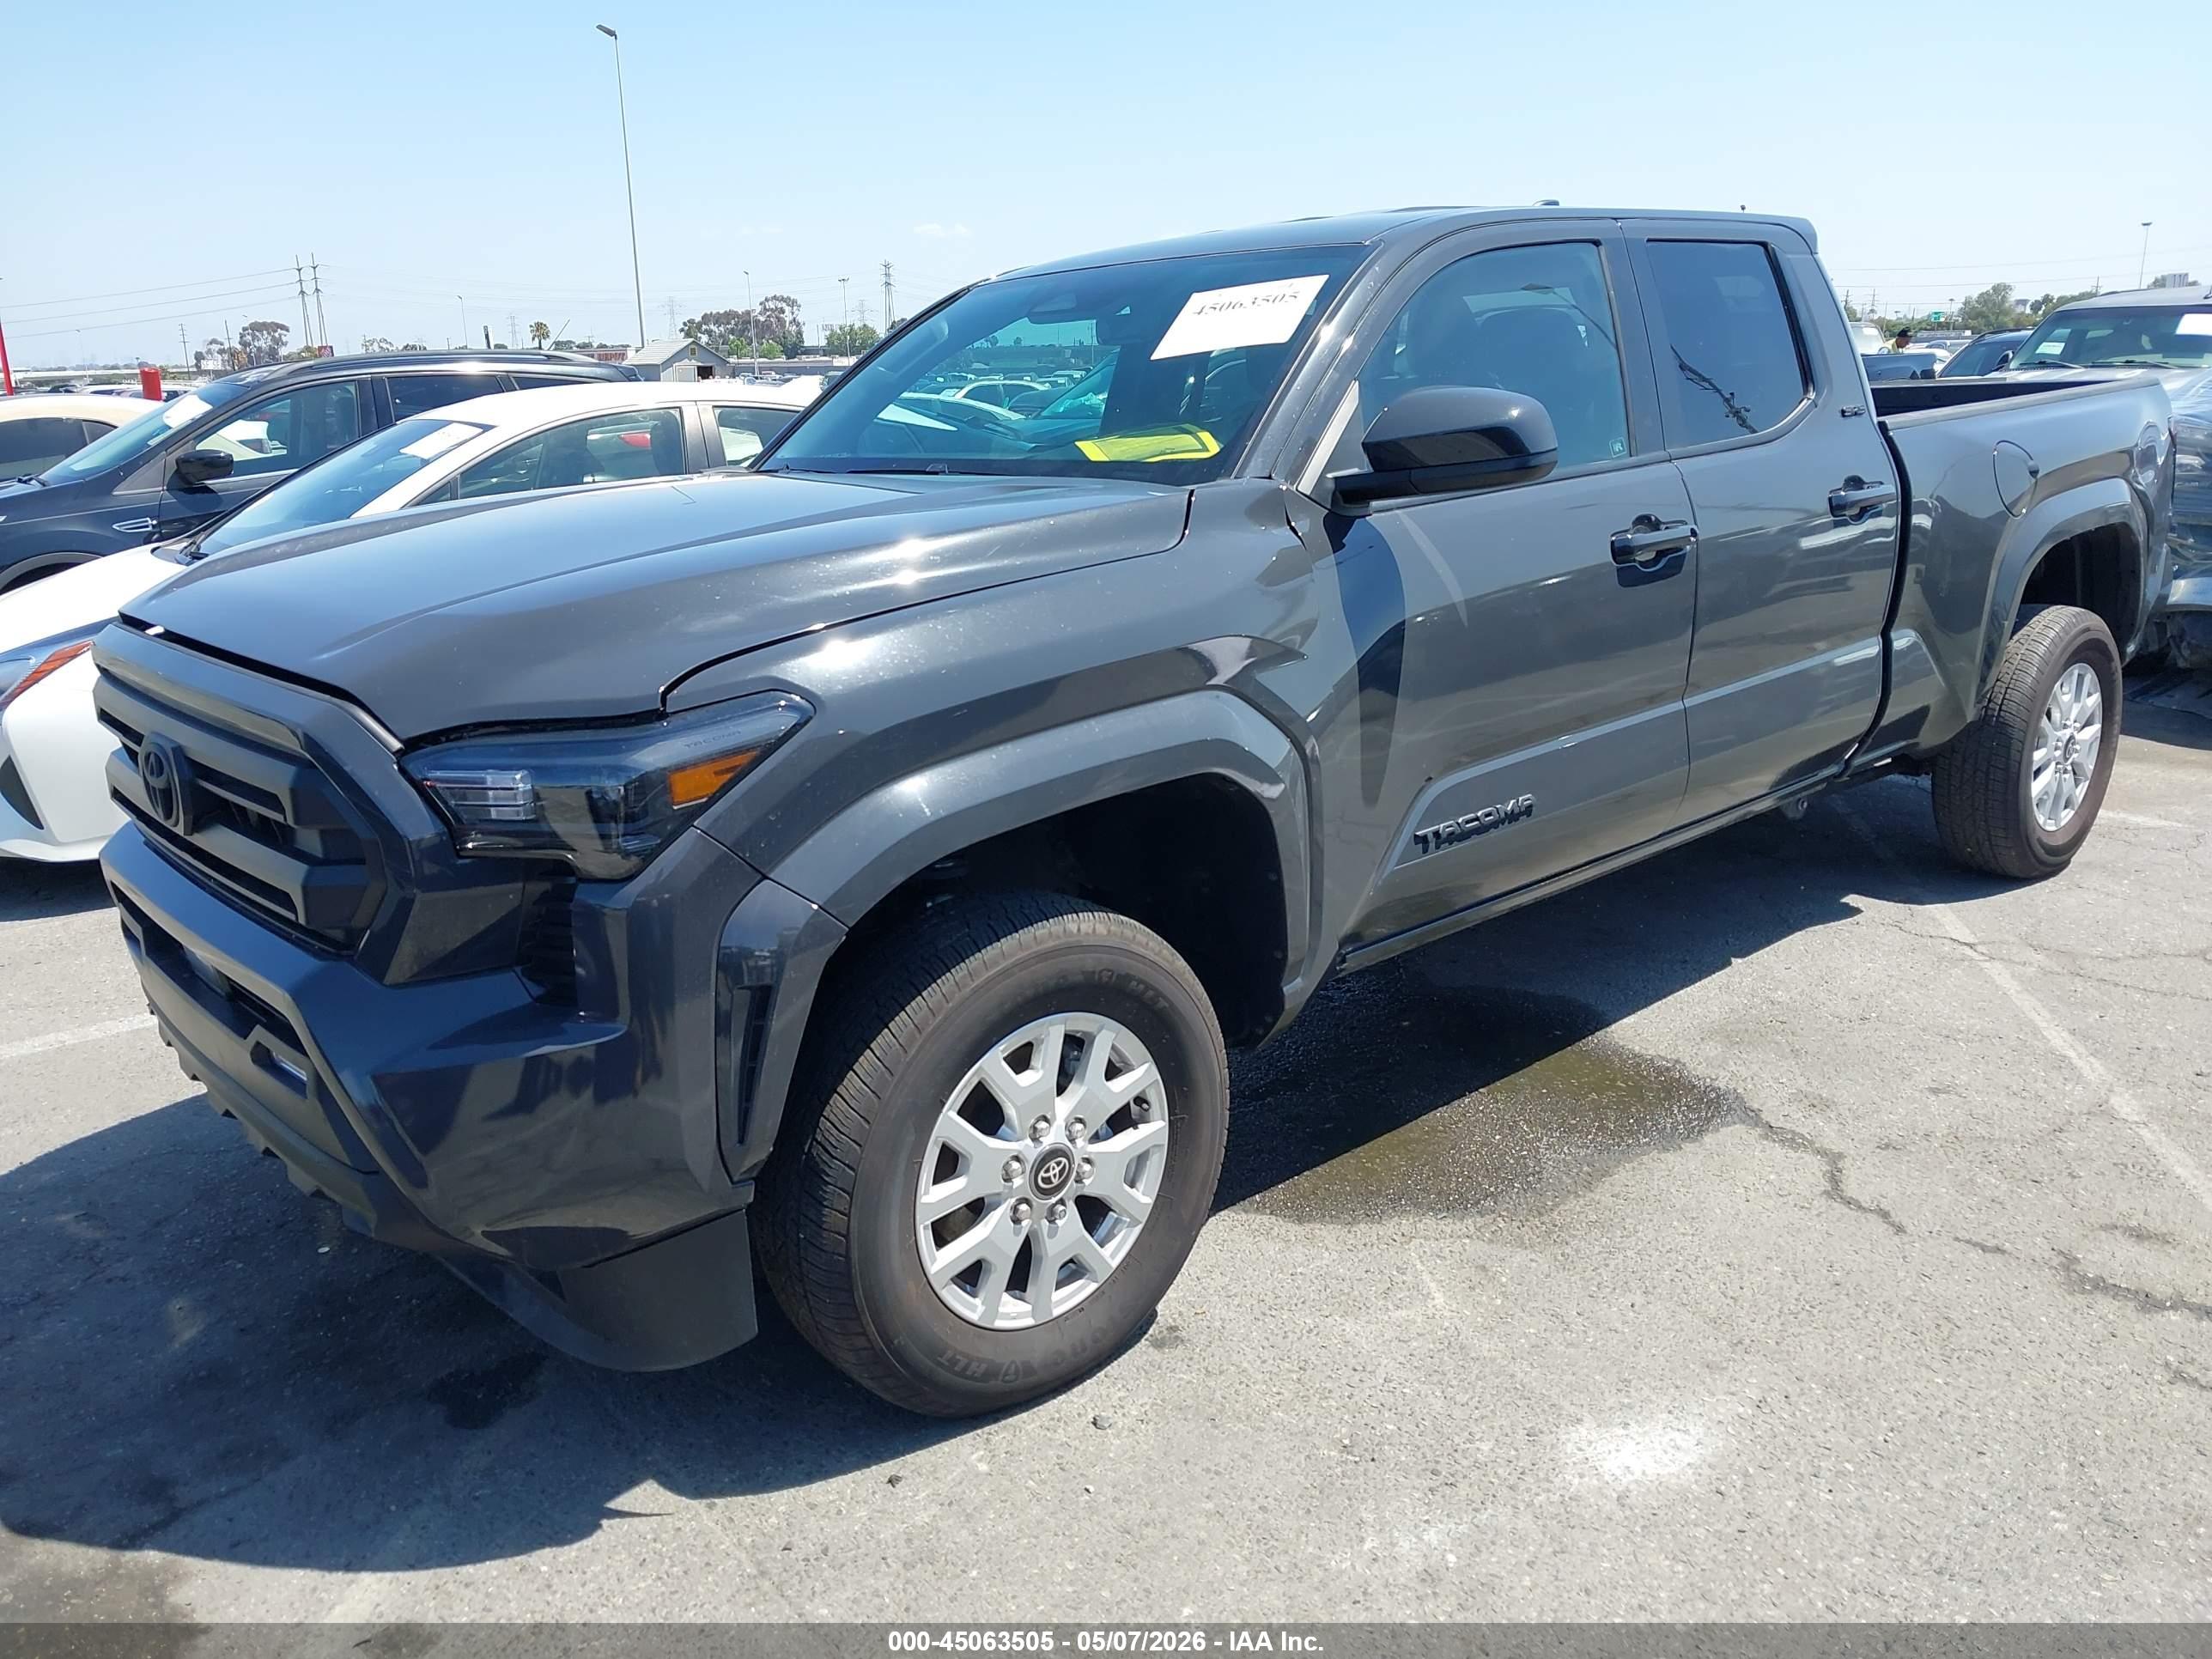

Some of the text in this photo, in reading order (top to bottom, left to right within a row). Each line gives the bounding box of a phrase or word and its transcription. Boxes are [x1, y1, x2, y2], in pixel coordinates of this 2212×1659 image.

[1193, 291, 1299, 315] 45063505
[1414, 793, 1534, 854] TACOMA
[937, 1350, 988, 1378] HLT
